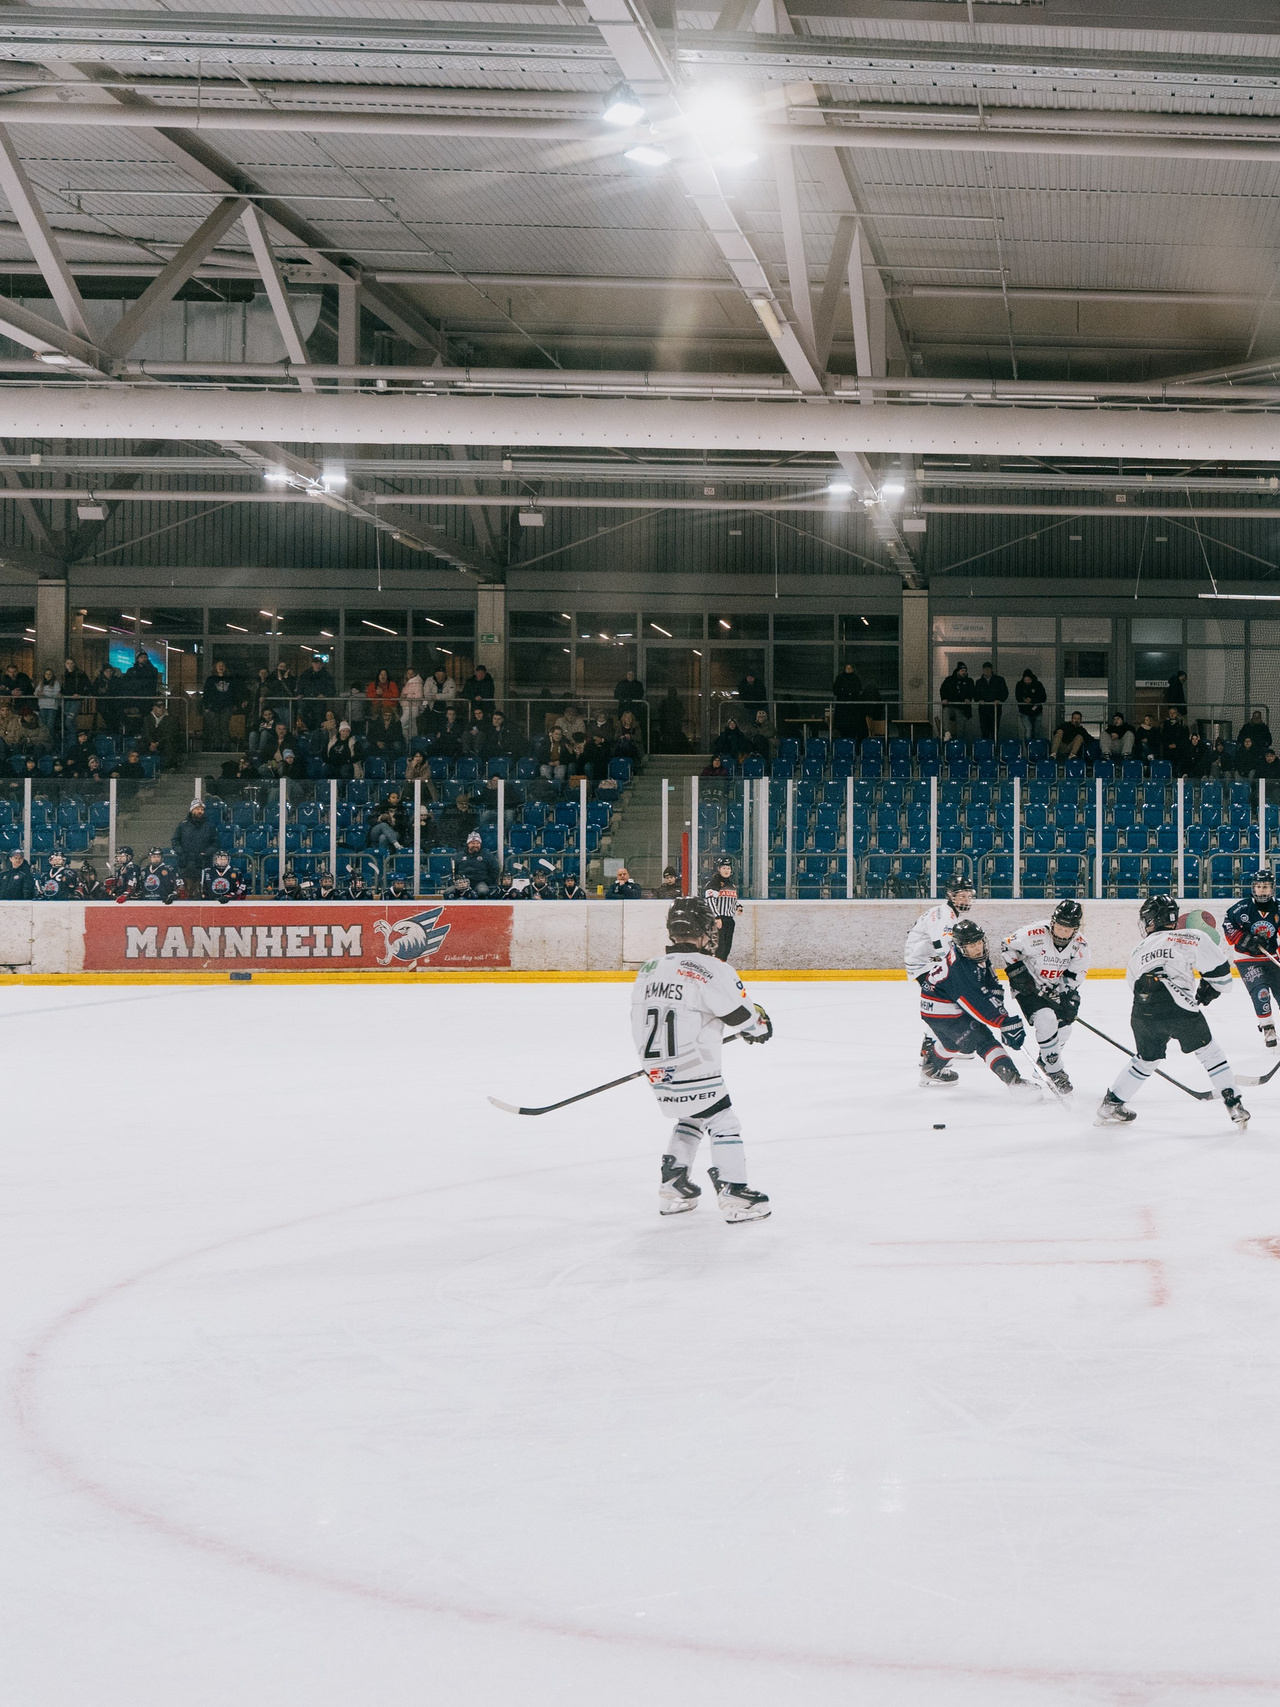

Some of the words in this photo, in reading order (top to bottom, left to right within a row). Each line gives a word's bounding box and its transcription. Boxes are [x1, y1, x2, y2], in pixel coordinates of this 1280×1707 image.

[1027, 928, 1046, 937] FKN
[125, 925, 363, 959] MANNHEIM
[1167, 937, 1199, 947] NISSAN
[677, 968, 708, 984] NISSAN
[644, 1006, 676, 1059] 21
